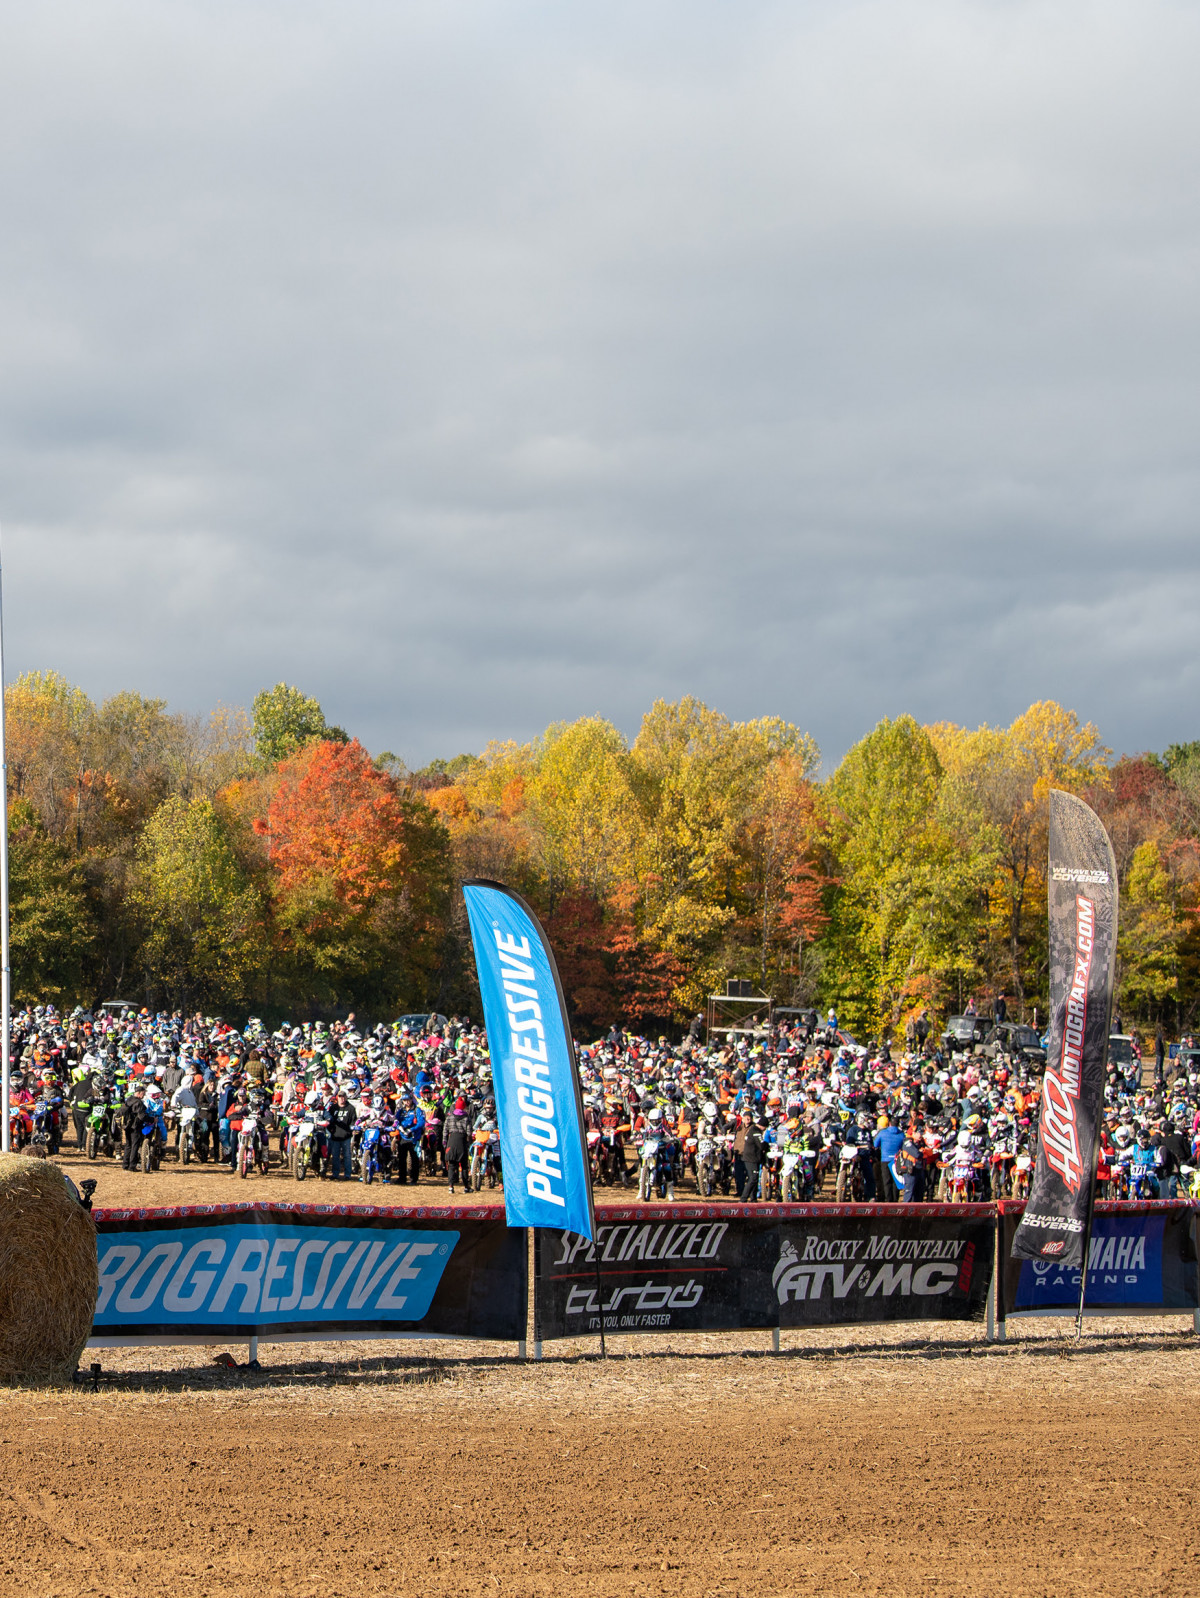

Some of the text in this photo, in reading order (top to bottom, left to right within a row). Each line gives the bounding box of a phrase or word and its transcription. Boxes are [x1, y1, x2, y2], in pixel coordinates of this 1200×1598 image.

[1052, 873, 1109, 883] COVERED
[1061, 897, 1093, 1096] MOTOGRAFX.COM
[494, 929, 565, 1207] PROGRESSIVE
[971, 1135, 982, 1145] FLY
[1023, 1212, 1037, 1220] WE
[1038, 1214, 1066, 1223] HAVE
[553, 1222, 730, 1265] SPECIALIZED
[801, 1235, 966, 1261] ROCKY MOUNTAIN
[1058, 1236, 1145, 1271] MAHA
[94, 1238, 438, 1314] ROGRESSIVE
[1035, 1275, 1138, 1286] RACING
[565, 1279, 704, 1314] turbo
[603, 1316, 619, 1329] YOU,
[620, 1315, 641, 1327] ONLY
[641, 1314, 671, 1326] FASTER
